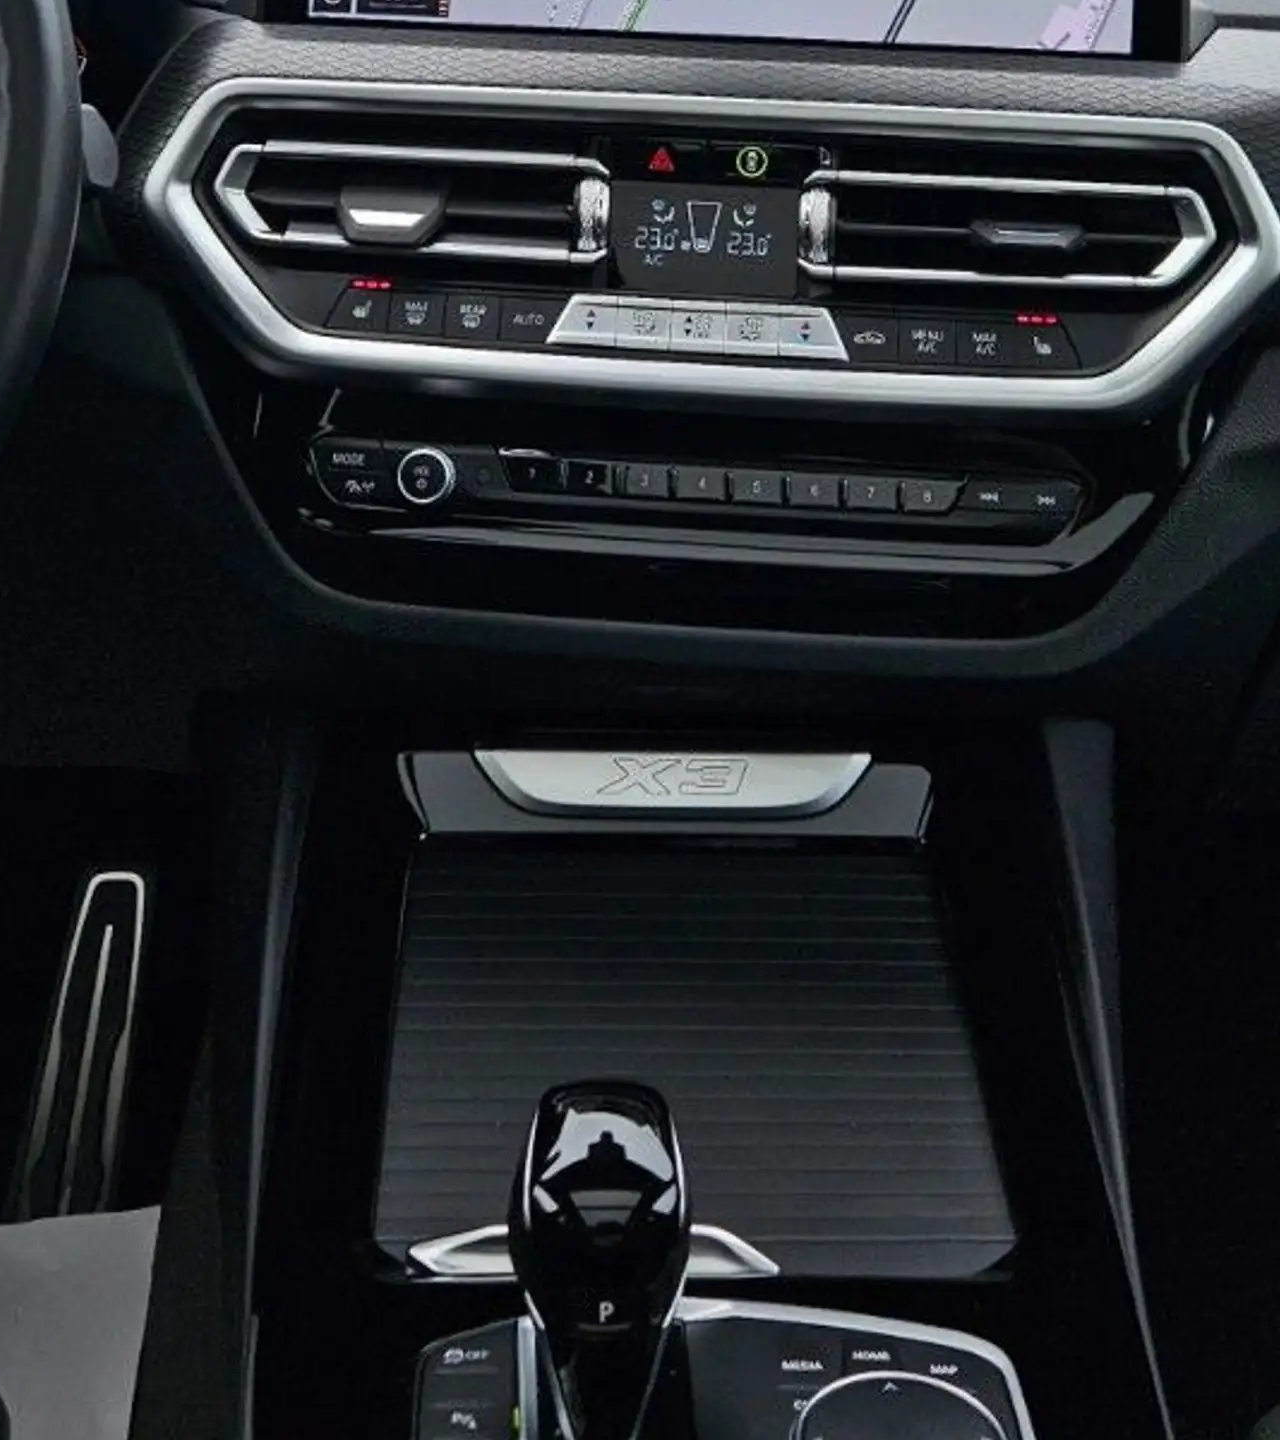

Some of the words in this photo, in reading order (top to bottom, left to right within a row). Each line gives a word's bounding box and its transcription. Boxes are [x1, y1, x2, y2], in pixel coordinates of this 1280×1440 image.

[512, 313, 545, 326] AUTO
[596, 757, 749, 796] X3
[599, 1300, 615, 1323] P
